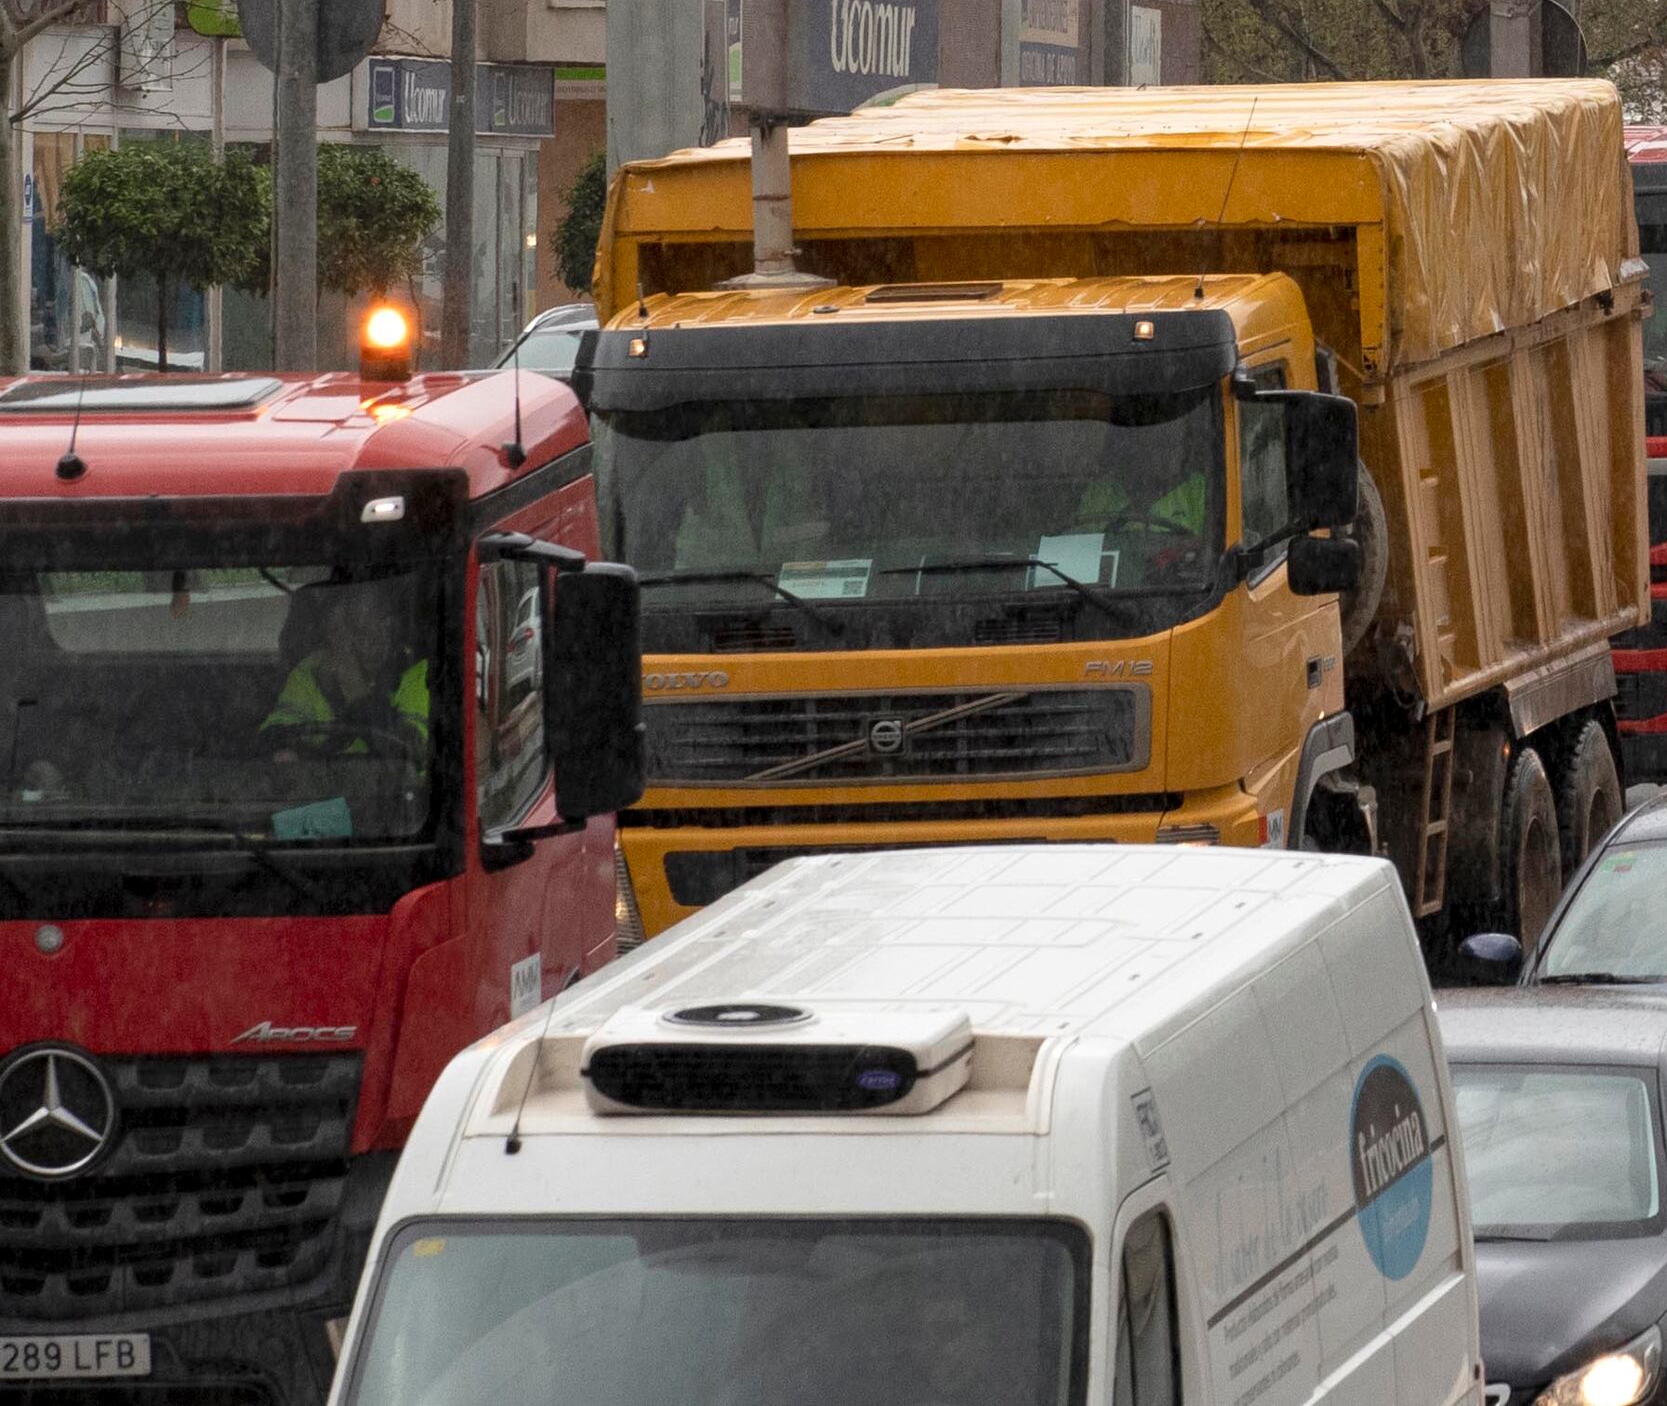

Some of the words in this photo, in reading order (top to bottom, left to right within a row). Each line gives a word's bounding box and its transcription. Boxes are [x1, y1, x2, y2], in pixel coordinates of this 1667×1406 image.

[641, 671, 729, 690] OLVO
[1357, 1102, 1426, 1199] fricocina
[74, 1339, 137, 1371] LFB
